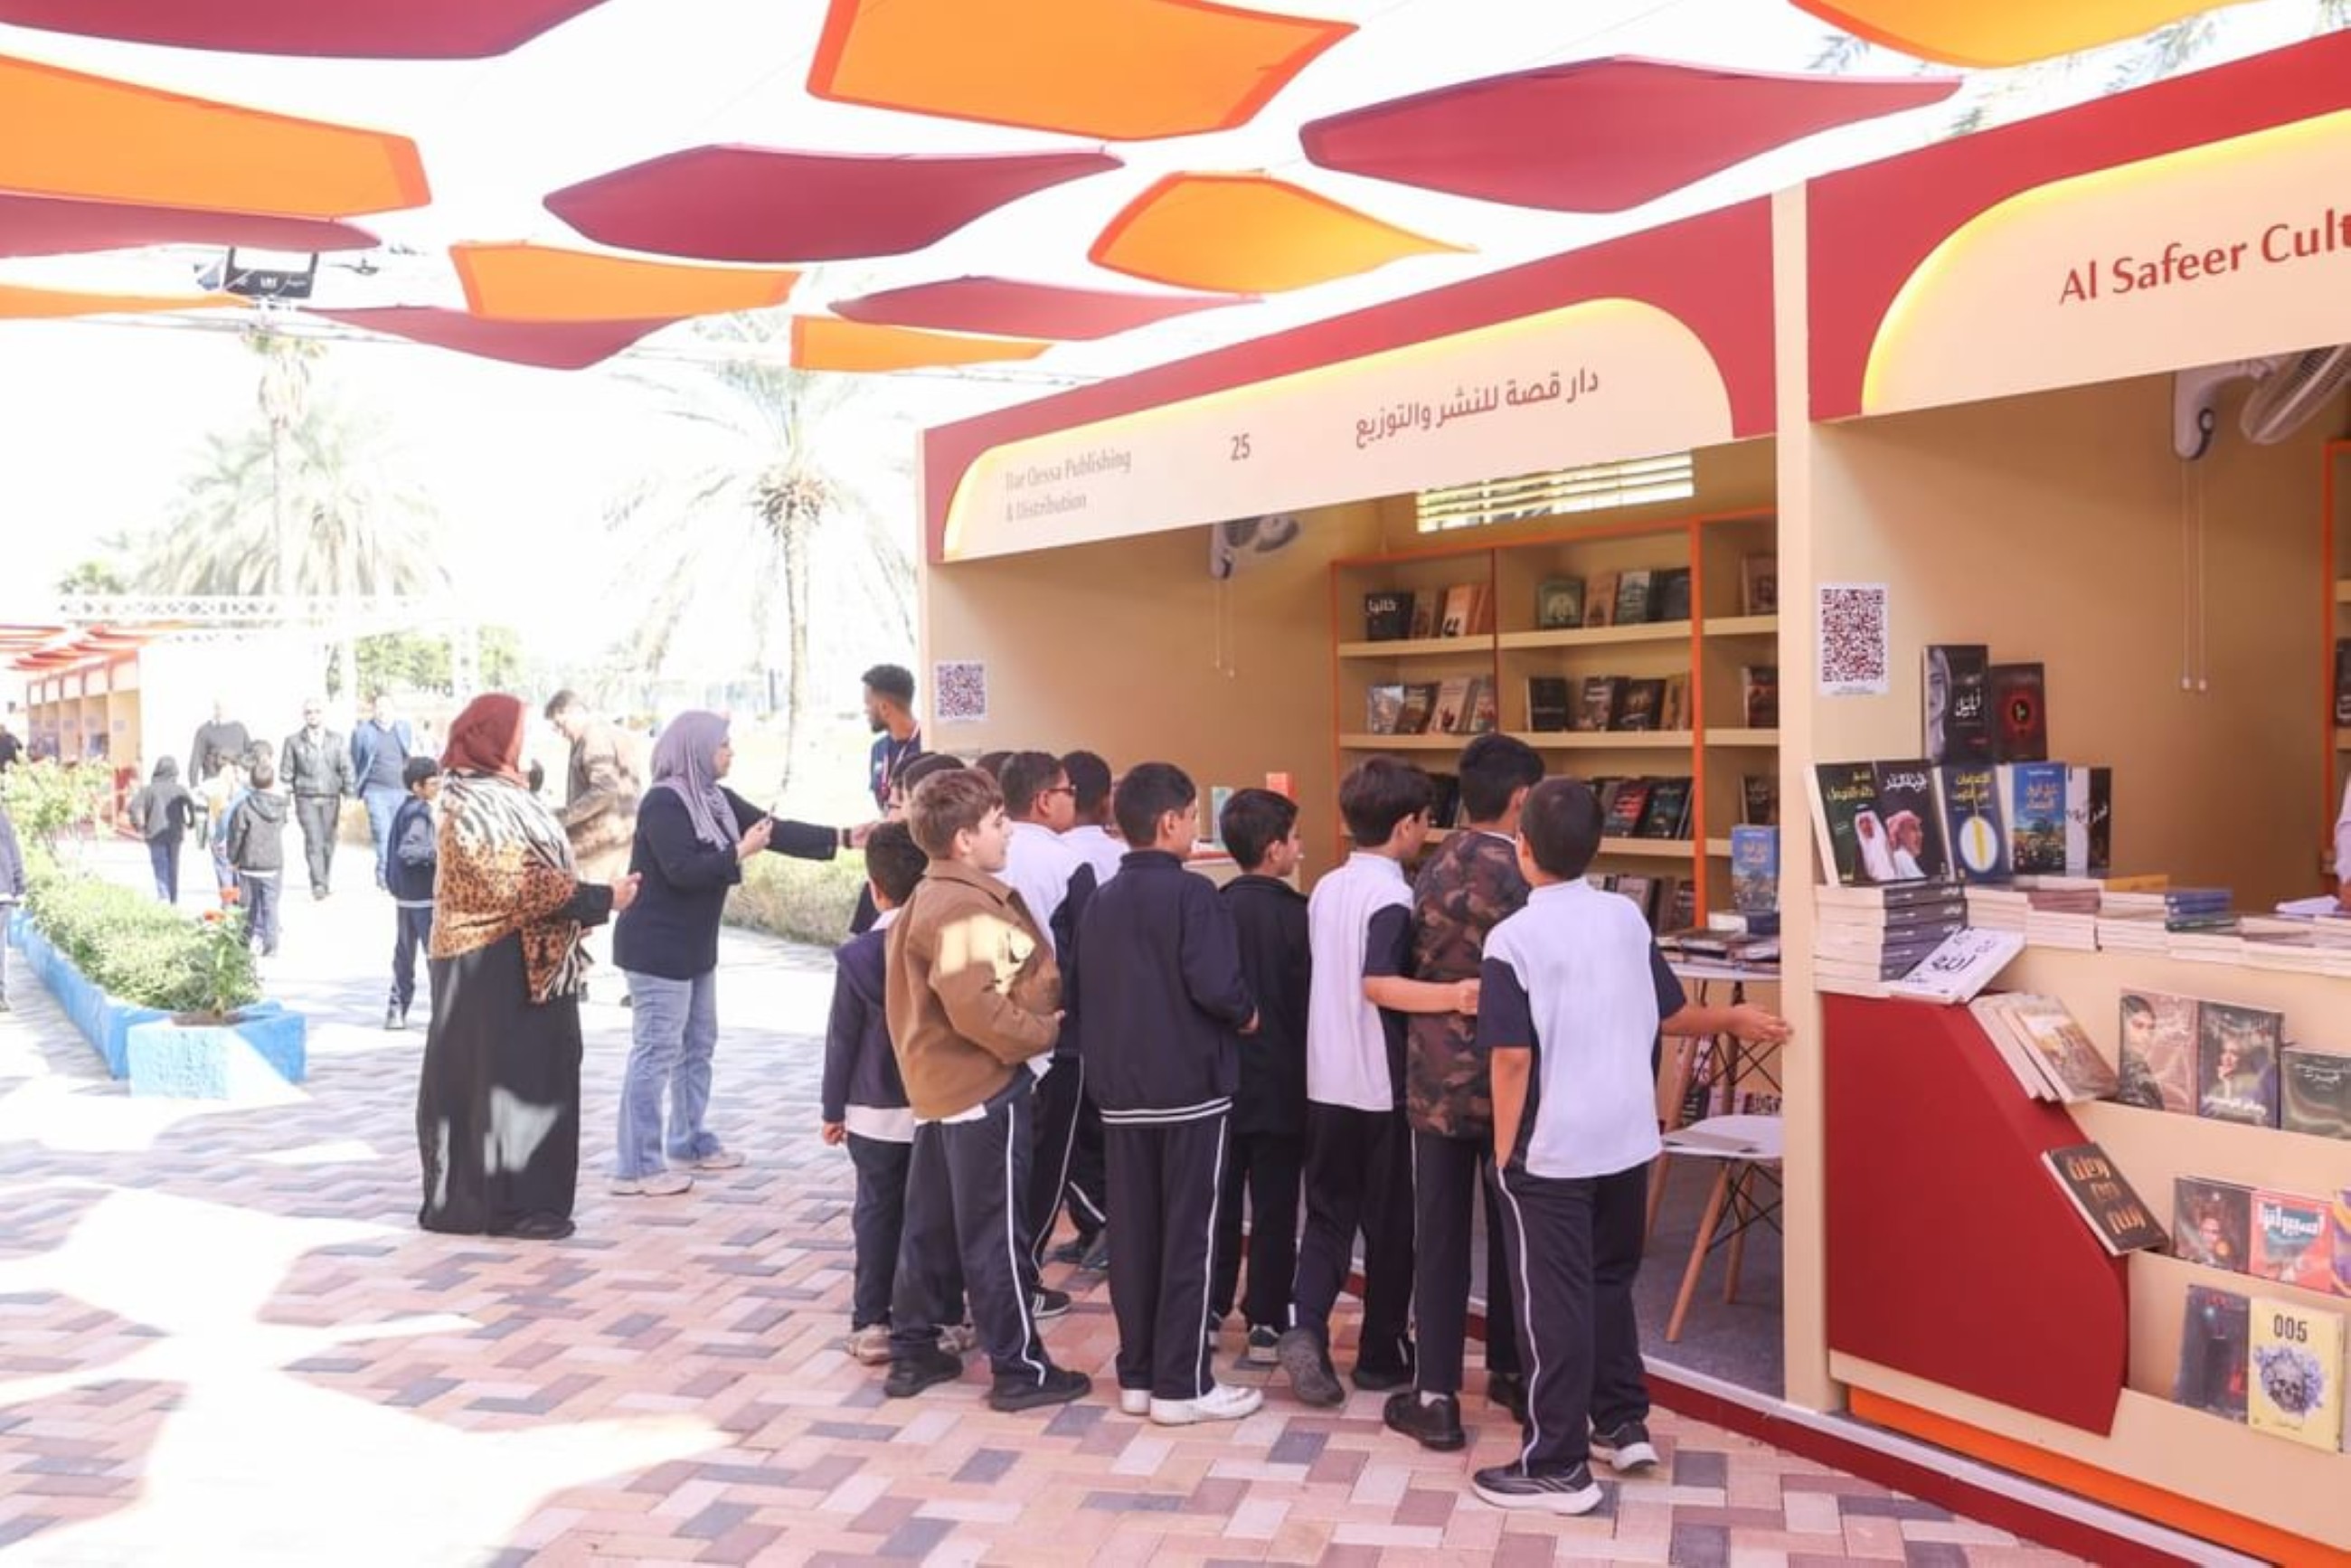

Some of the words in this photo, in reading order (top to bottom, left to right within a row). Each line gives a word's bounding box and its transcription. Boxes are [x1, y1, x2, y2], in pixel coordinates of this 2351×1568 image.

[2060, 260, 2098, 304] Al
[2112, 241, 2247, 293] Safeer
[1506, 371, 1563, 407] قصة
[1567, 367, 1600, 403] دار
[1436, 384, 1498, 429] للنشر
[1355, 404, 1431, 449] والتوزيع
[1065, 448, 1132, 479] Publishing
[1231, 433, 1251, 461] 25
[2273, 1314, 2308, 1342] 005
